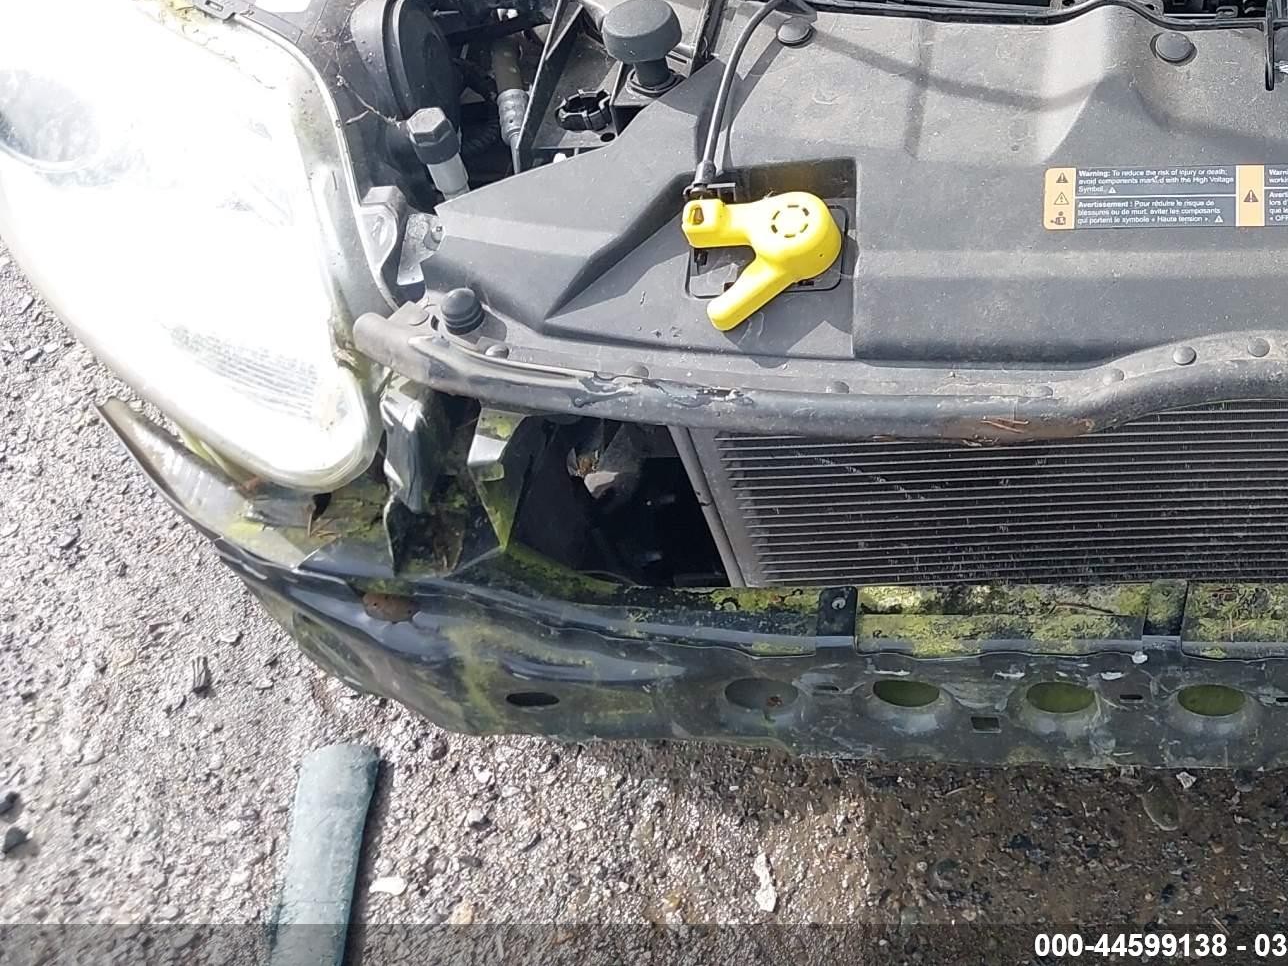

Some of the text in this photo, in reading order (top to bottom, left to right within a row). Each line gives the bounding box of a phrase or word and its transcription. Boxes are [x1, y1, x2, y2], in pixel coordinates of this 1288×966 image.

[1078, 170, 1111, 178] Warning:
[1179, 169, 1197, 177] injury
[1078, 177, 1097, 185] avoid
[1209, 176, 1234, 184] Voltage
[1184, 200, 1205, 208] risque
[1122, 216, 1149, 224] symbole
